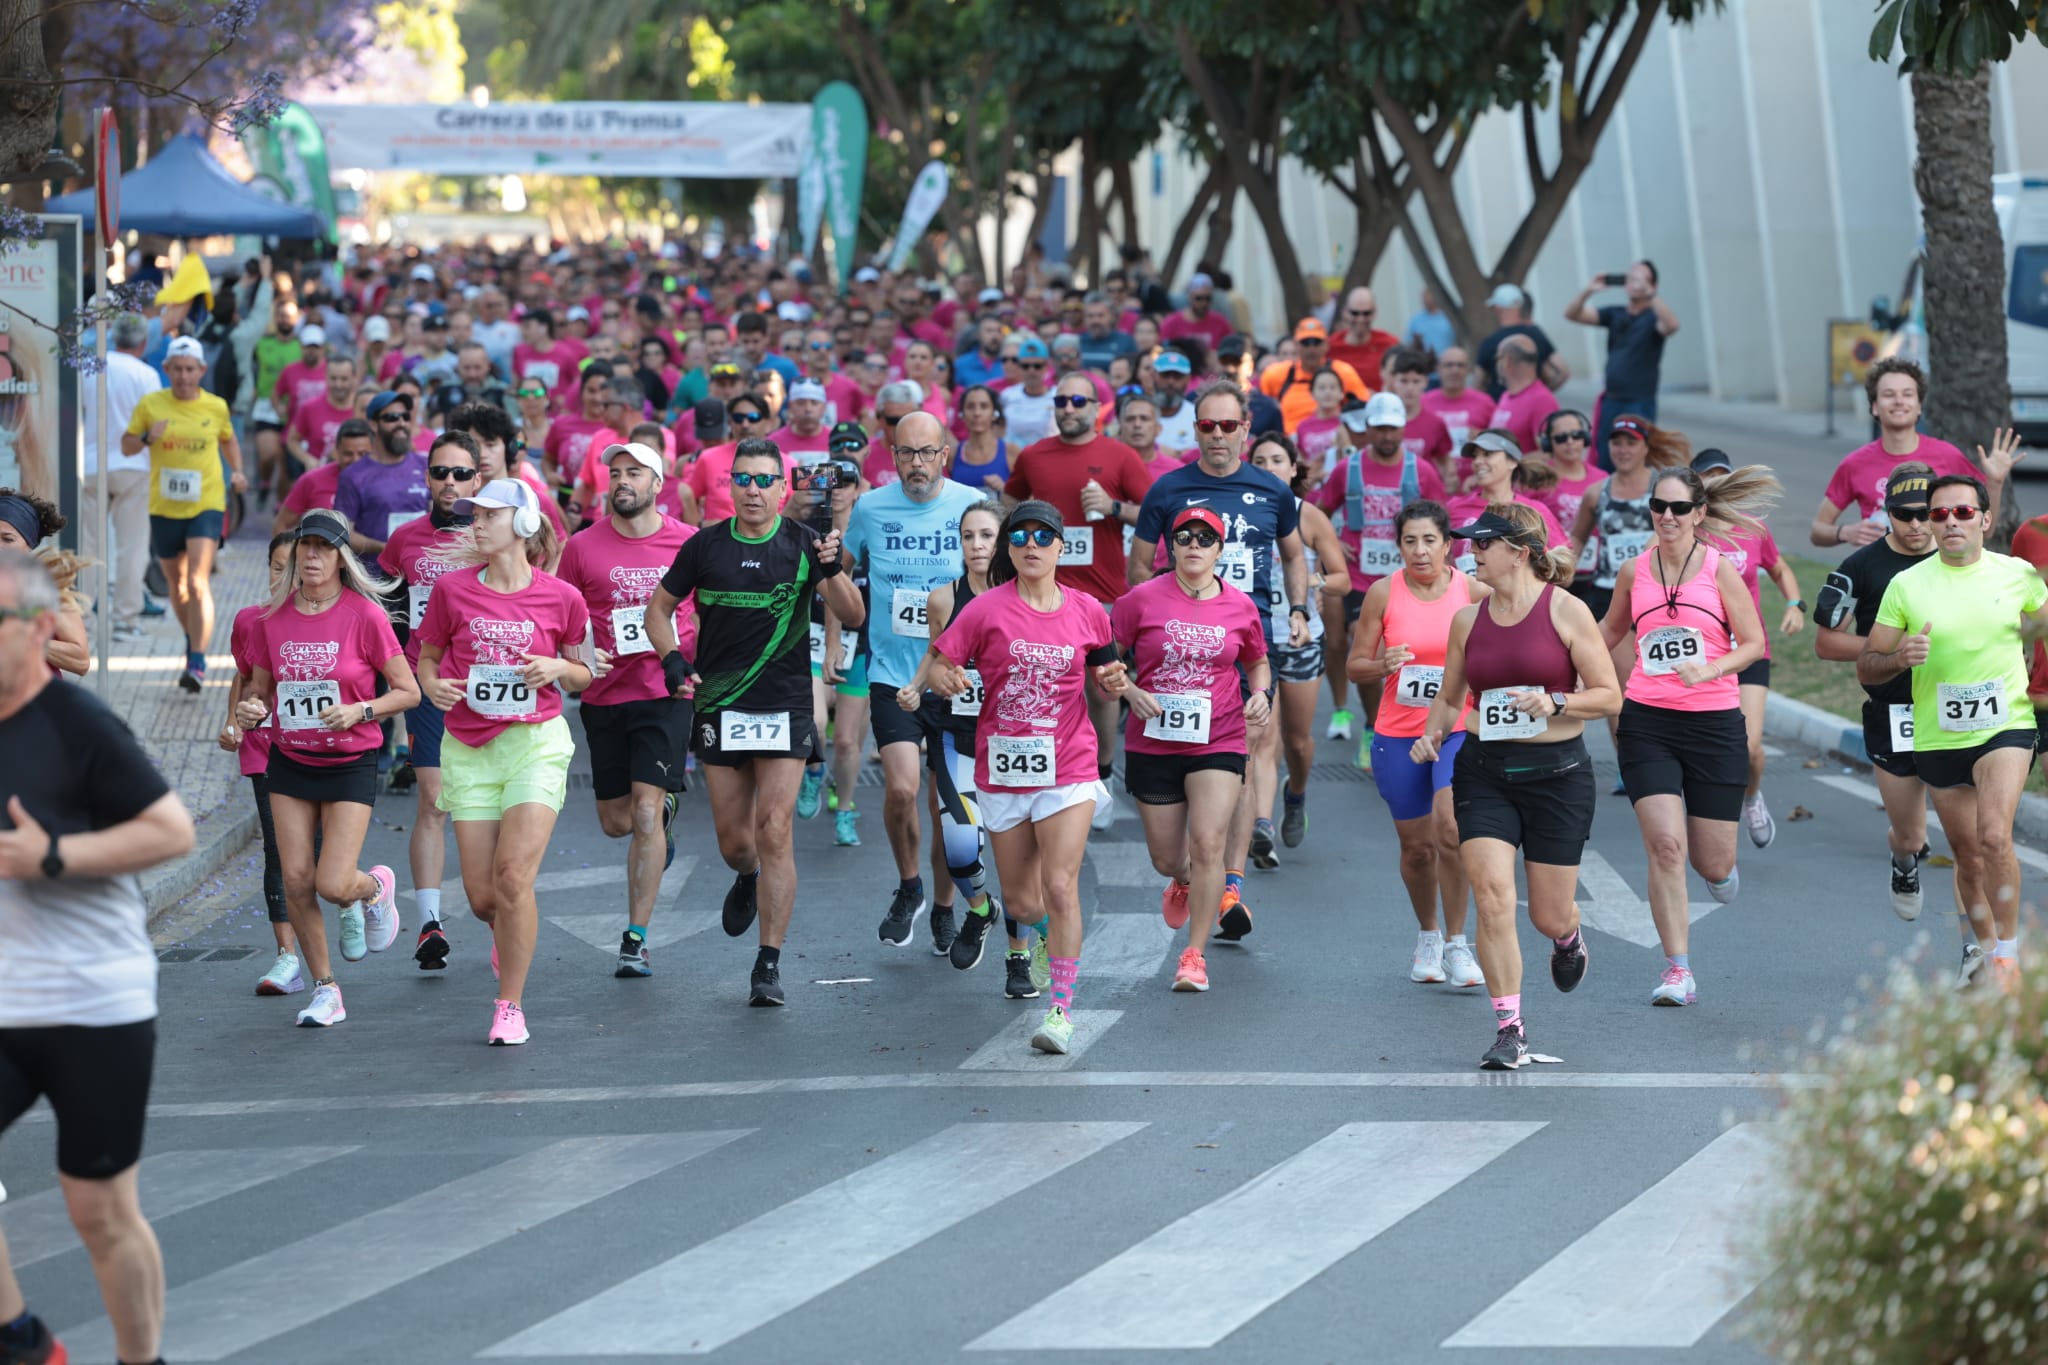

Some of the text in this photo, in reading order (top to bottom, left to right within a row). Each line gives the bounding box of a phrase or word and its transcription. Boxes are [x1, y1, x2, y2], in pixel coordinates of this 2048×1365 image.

[435, 108, 530, 129] Carrera
[536, 109, 568, 130] de
[602, 110, 687, 131] Prensa
[885, 530, 958, 555] nerja
[894, 557, 950, 566] ATLETISMO
[1367, 551, 1403, 565] 594
[899, 607, 929, 625] 45
[623, 624, 645, 641] 3
[1648, 638, 1698, 661] 469
[475, 682, 529, 702] 670
[1406, 680, 1440, 699] 16
[283, 696, 334, 717] 110
[1945, 696, 1999, 719] 371
[1155, 709, 1201, 731] 191
[730, 723, 781, 740] 217
[996, 753, 1048, 773] 343
